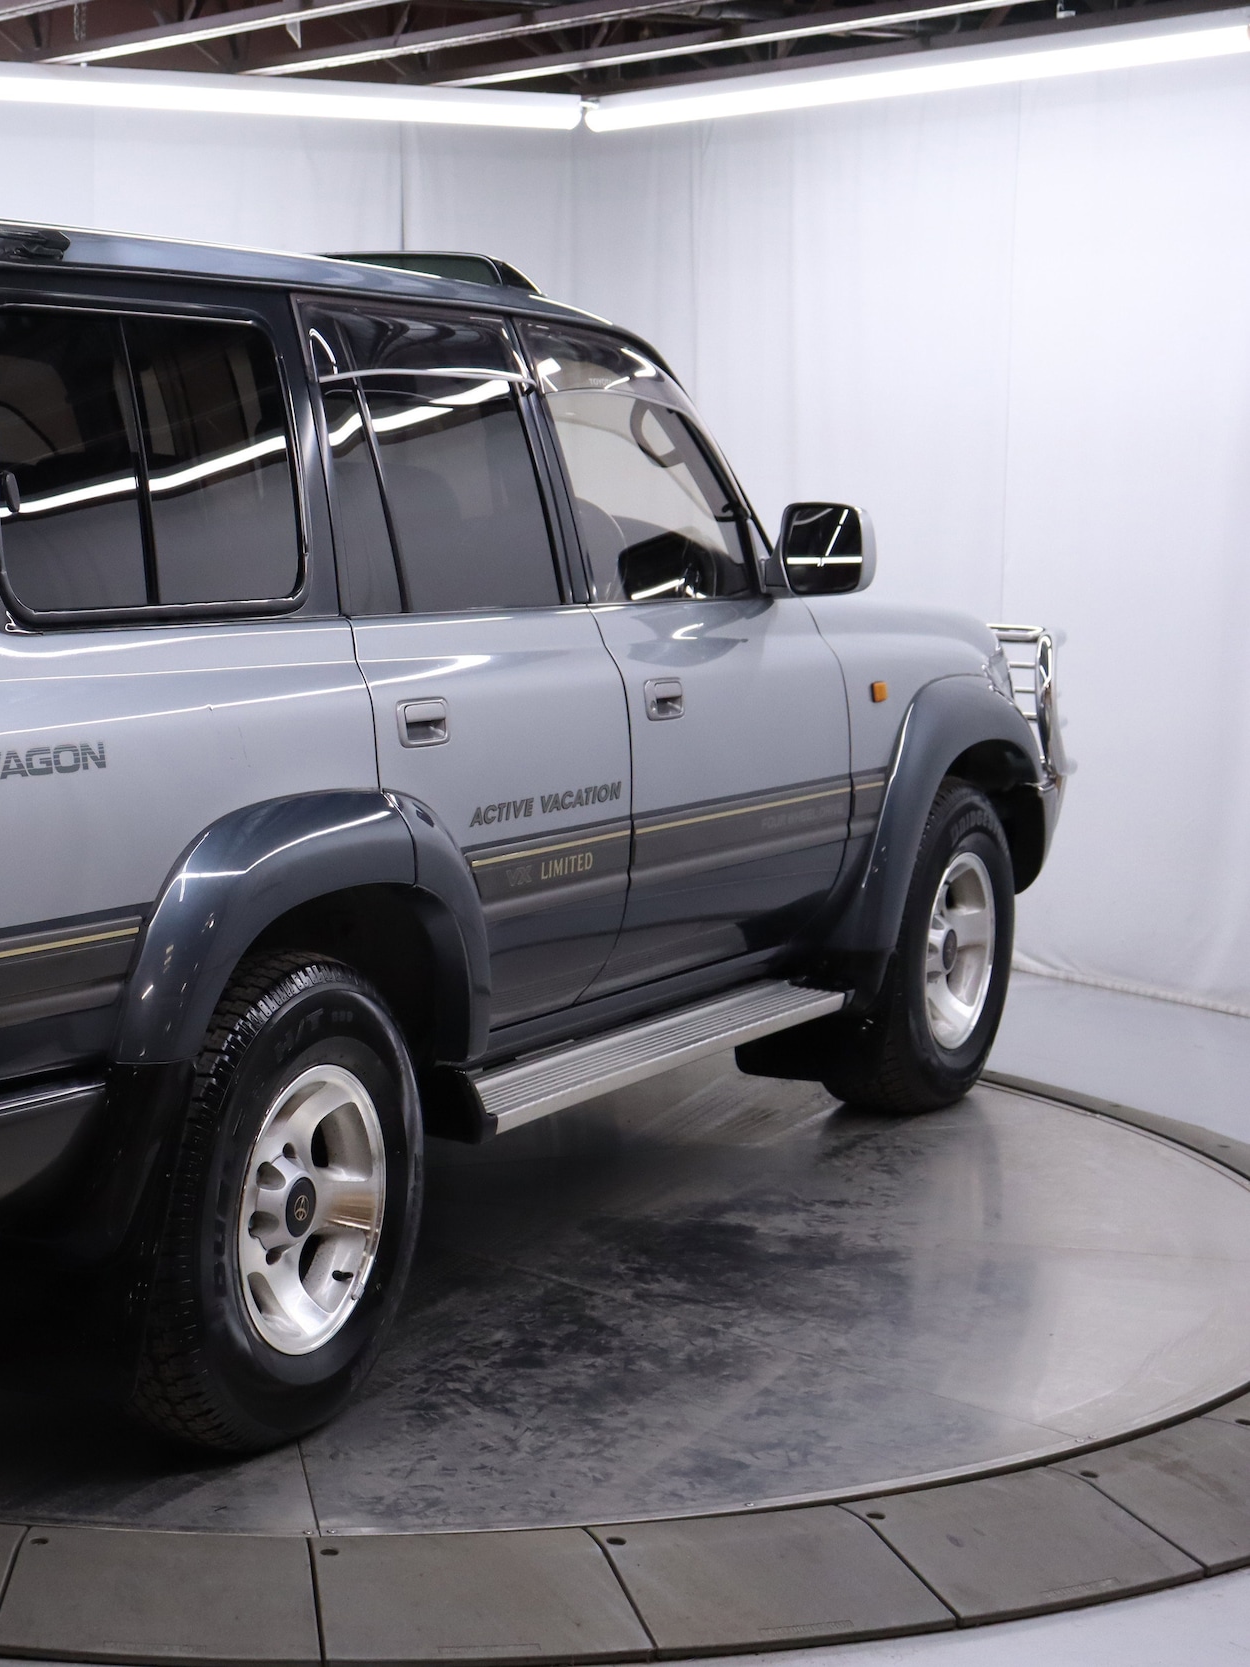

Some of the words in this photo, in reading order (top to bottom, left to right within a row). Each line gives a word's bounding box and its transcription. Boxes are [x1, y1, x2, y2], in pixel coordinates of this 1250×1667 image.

[469, 796, 534, 828] ACTIVE
[541, 782, 622, 814] VACATION
[506, 865, 532, 887] VX
[541, 852, 593, 880] LIMITED
